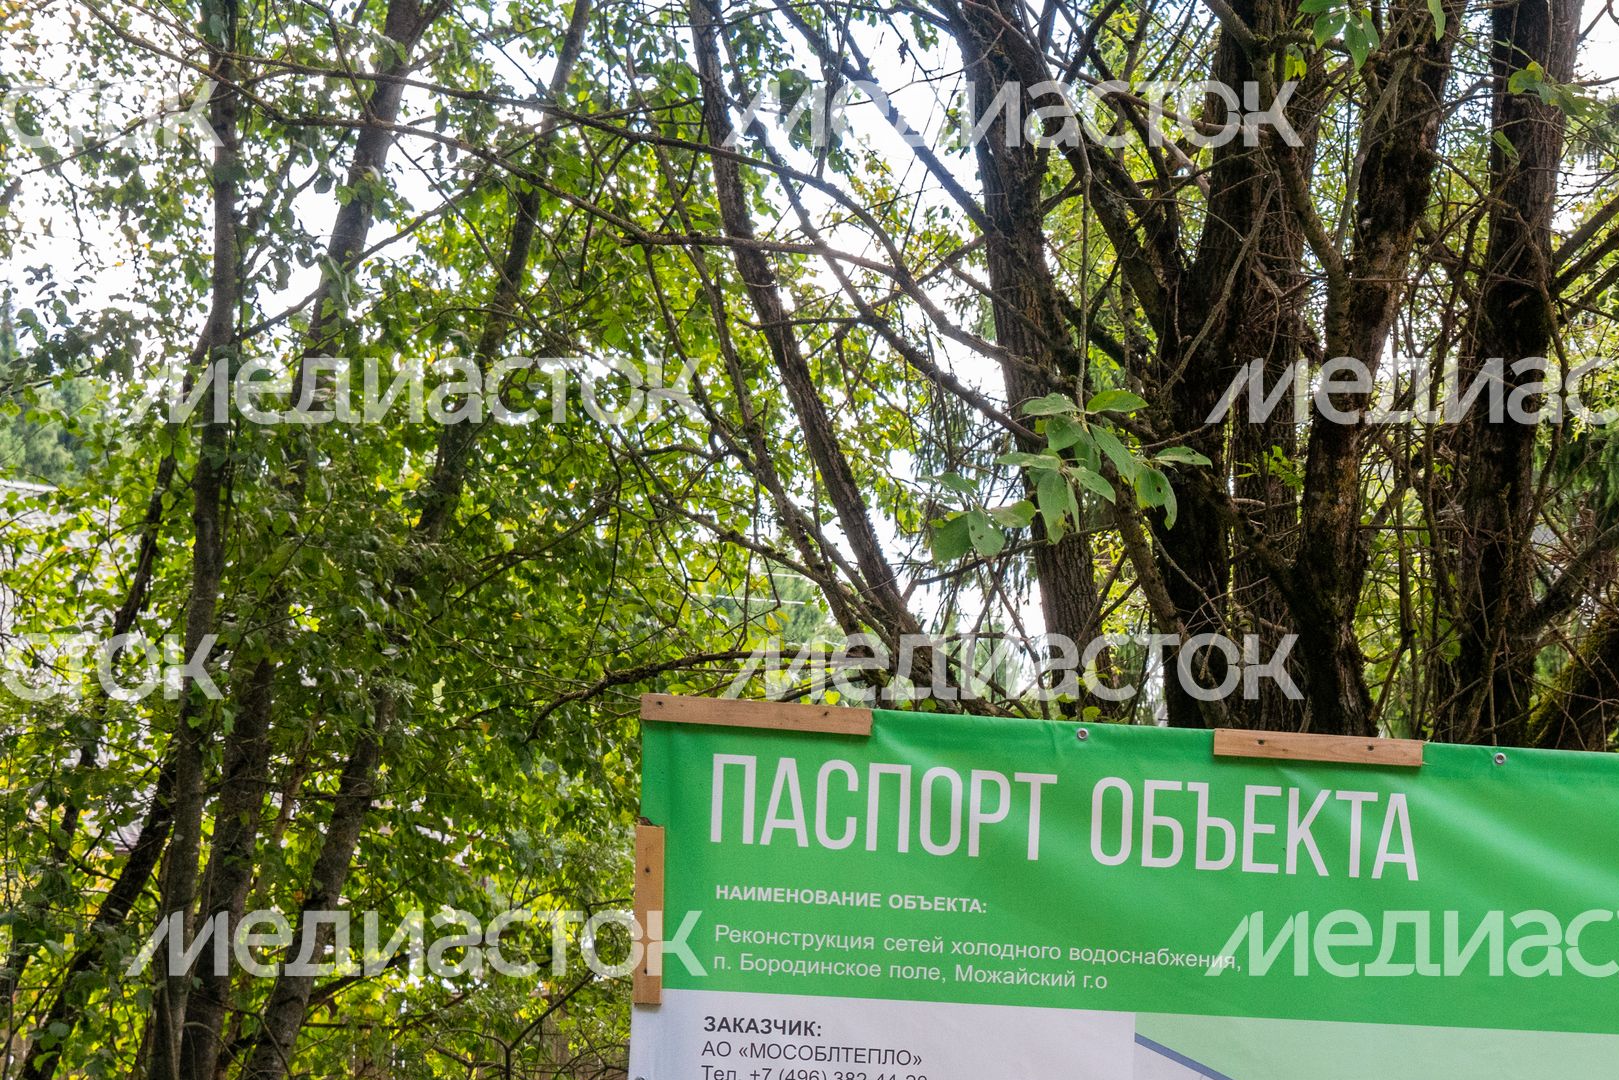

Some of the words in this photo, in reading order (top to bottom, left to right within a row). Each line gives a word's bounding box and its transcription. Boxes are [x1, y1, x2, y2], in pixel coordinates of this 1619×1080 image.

[711, 752, 1057, 860] ПАСПОРТ
[1089, 776, 1419, 882] ОБЪЕКТА
[716, 885, 881, 907] НАИМЕНОВАНИЕ
[889, 894, 986, 913] ОБЪЕКТА:
[716, 925, 874, 951] Реконструкция
[884, 936, 943, 953] сетей
[951, 941, 1061, 960] холодного
[1069, 943, 1241, 971] водоснабжения,
[714, 956, 731, 969] п.
[741, 953, 881, 977] Бородинское
[890, 965, 945, 983] поле,
[956, 964, 1075, 987] Можайский
[1084, 976, 1107, 989] г.о
[704, 1016, 821, 1036] ЗАКАЗЧИК:
[702, 1041, 731, 1057] АО
[739, 1043, 921, 1065] «МОСОБЛТЕПЛО»
